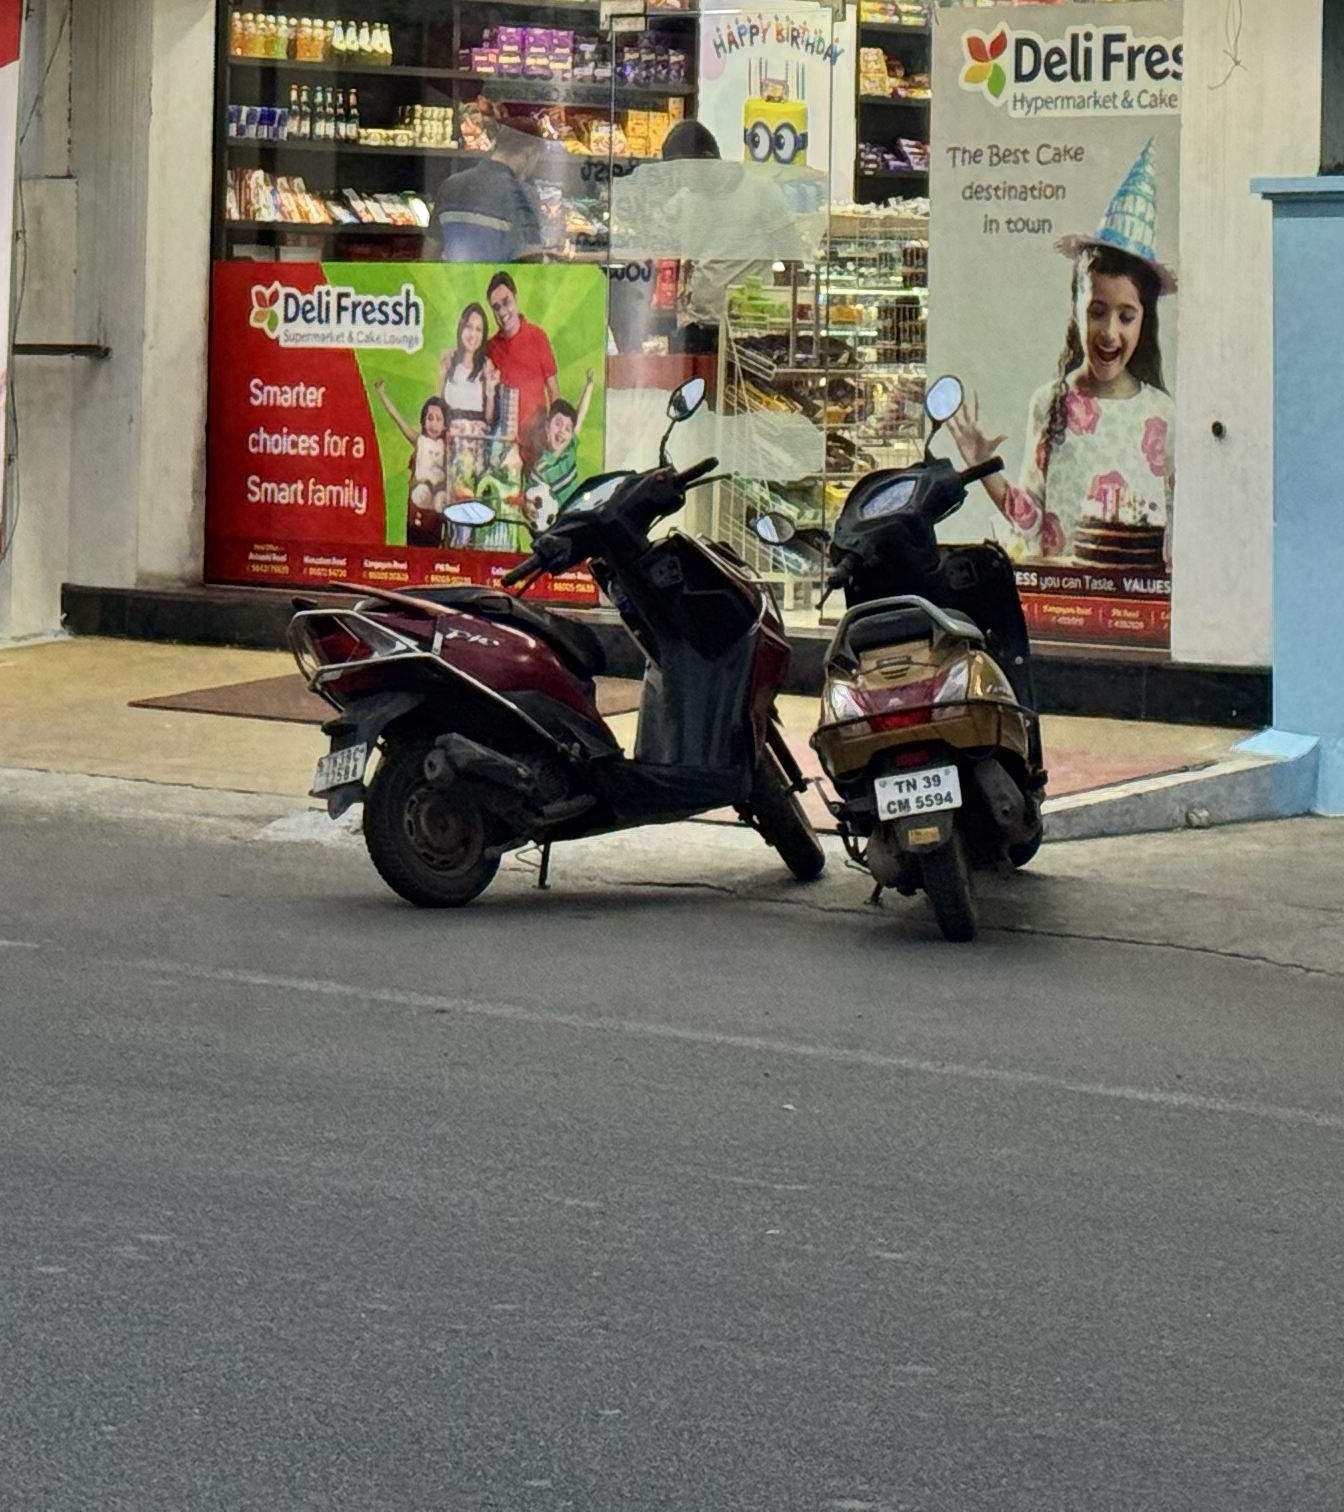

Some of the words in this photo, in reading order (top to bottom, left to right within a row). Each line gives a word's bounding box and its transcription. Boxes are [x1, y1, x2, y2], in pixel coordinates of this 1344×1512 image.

[713, 19, 771, 59] HAPPY
[775, 19, 845, 66] BIRTHDAY
[1013, 90, 1118, 116] Hypermarket
[1121, 89, 1134, 110] &
[1137, 88, 1178, 110] Cake
[946, 146, 984, 169] The
[987, 143, 1031, 168] Best
[1036, 143, 1085, 166] Cake
[961, 180, 1067, 202] destination
[982, 213, 1000, 234] in
[1004, 215, 1053, 234] town
[283, 329, 346, 345] Supermarket
[357, 330, 381, 345] Cake
[384, 331, 420, 347] Lounge
[249, 377, 327, 408] Smarter
[248, 426, 320, 457] choices
[324, 428, 351, 458] for
[352, 436, 365, 459] a
[246, 474, 305, 506] Smart
[307, 477, 368, 515] family
[1014, 571, 1038, 587] ESS
[1040, 575, 1060, 591] you
[1062, 576, 1082, 589] can
[1123, 577, 1171, 594] VALUES
[894, 777, 918, 794] TN
[922, 774, 942, 790] 39
[886, 798, 912, 814] CM
[914, 790, 954, 808] 5594
